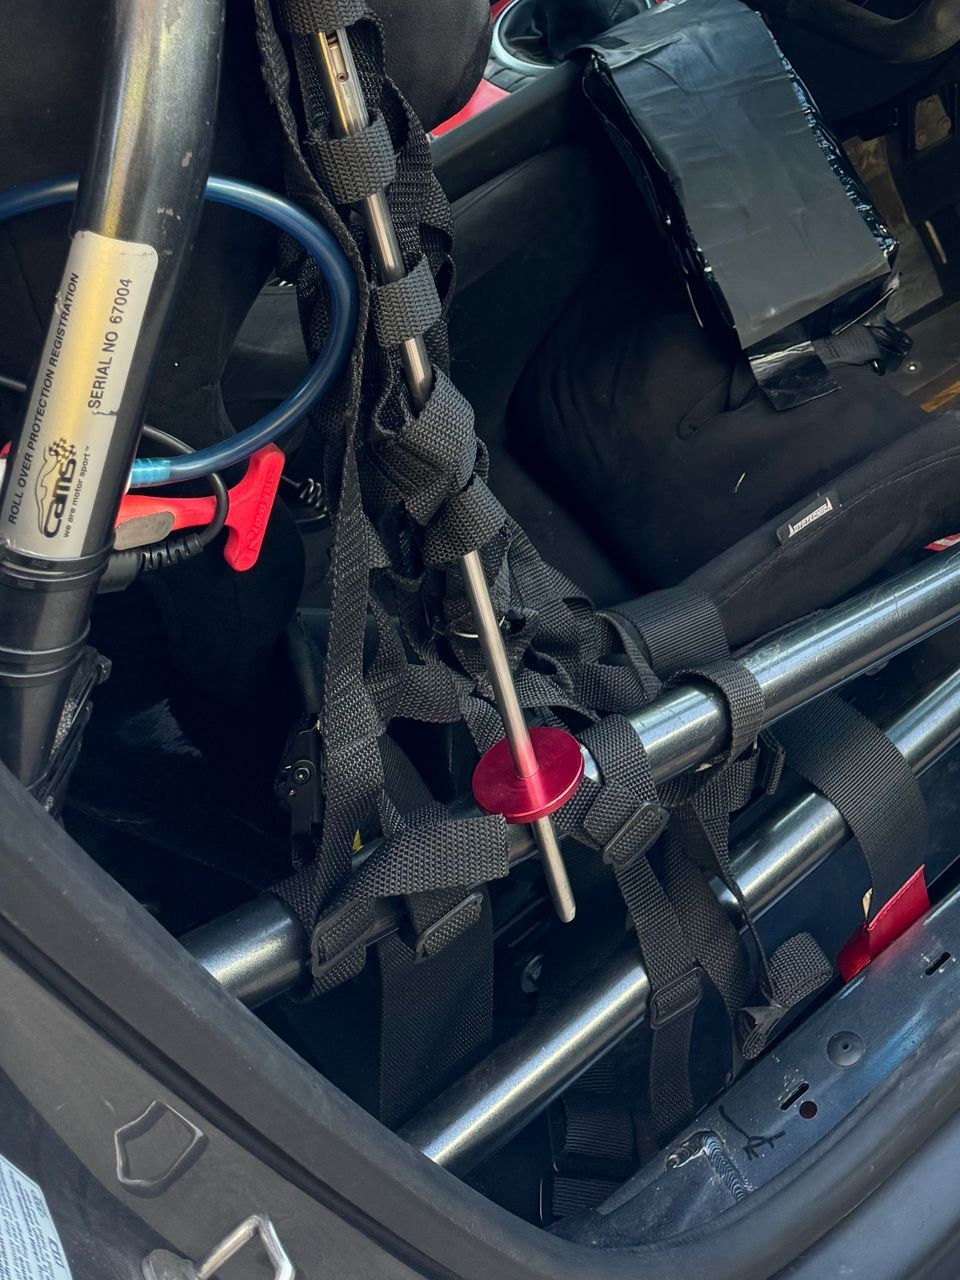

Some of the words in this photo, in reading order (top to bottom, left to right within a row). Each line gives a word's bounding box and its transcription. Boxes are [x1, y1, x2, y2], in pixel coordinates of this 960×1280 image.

[108, 277, 133, 326] 67004
[101, 330, 119, 354] NO
[87, 355, 113, 410] SERIAL
[8, 491, 24, 524] ROLL
[19, 454, 34, 488] OVER
[27, 370, 56, 450] PROTECTION
[49, 272, 79, 367] REGISTRATION
[70, 479, 84, 506] motor
[67, 507, 77, 524] are
[64, 525, 72, 538] we
